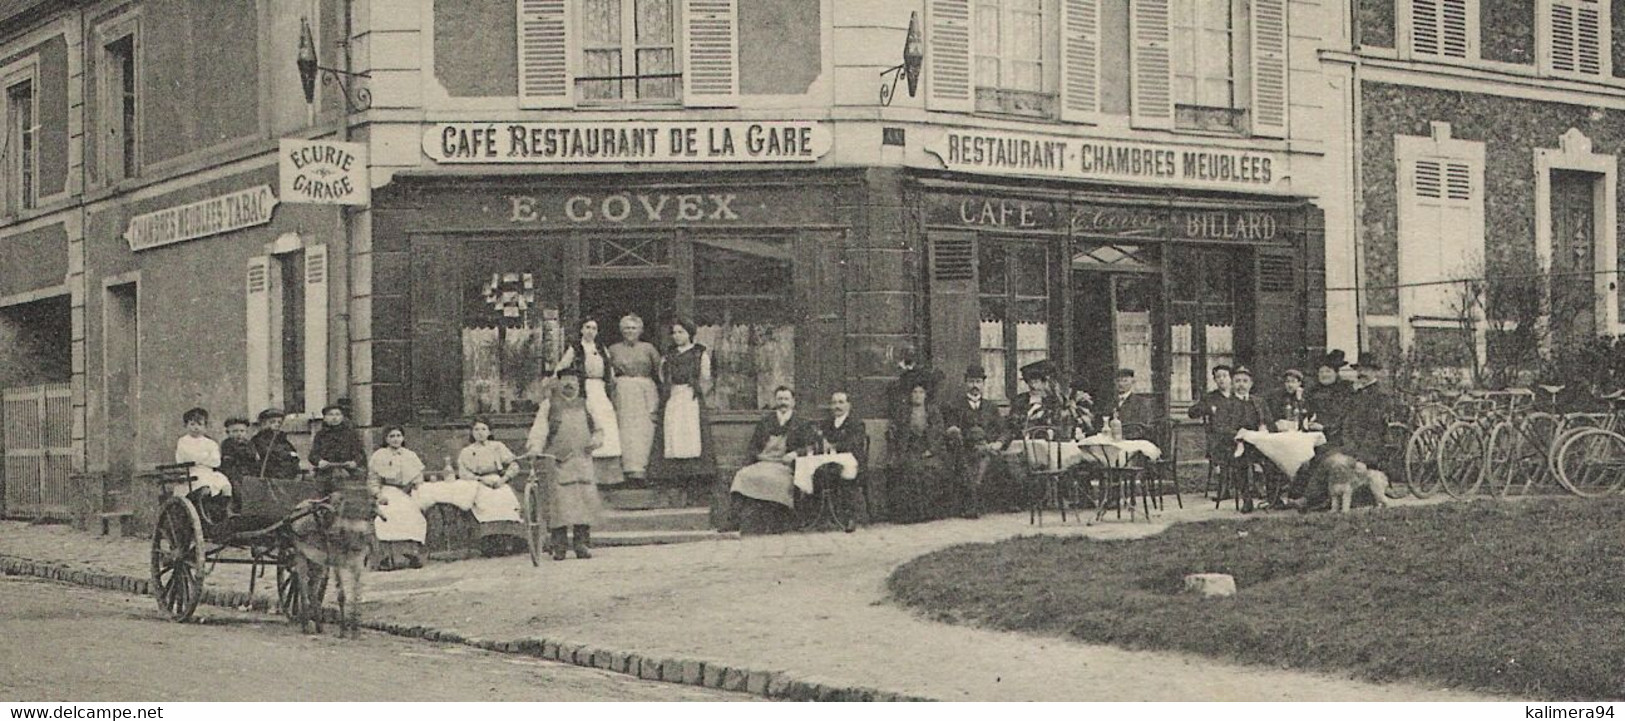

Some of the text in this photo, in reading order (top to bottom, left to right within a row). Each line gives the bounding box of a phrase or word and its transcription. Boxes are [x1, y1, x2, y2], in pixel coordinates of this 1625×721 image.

[442, 124, 812, 158] CAFÉ RESTAURANT DE LA GARE
[948, 134, 1271, 184] RESTAURANT CHAMBRES MEUBLÉES
[293, 174, 354, 199] GARAGE
[510, 194, 738, 222] E. COVEX
[1187, 213, 1276, 240] BILLARD
